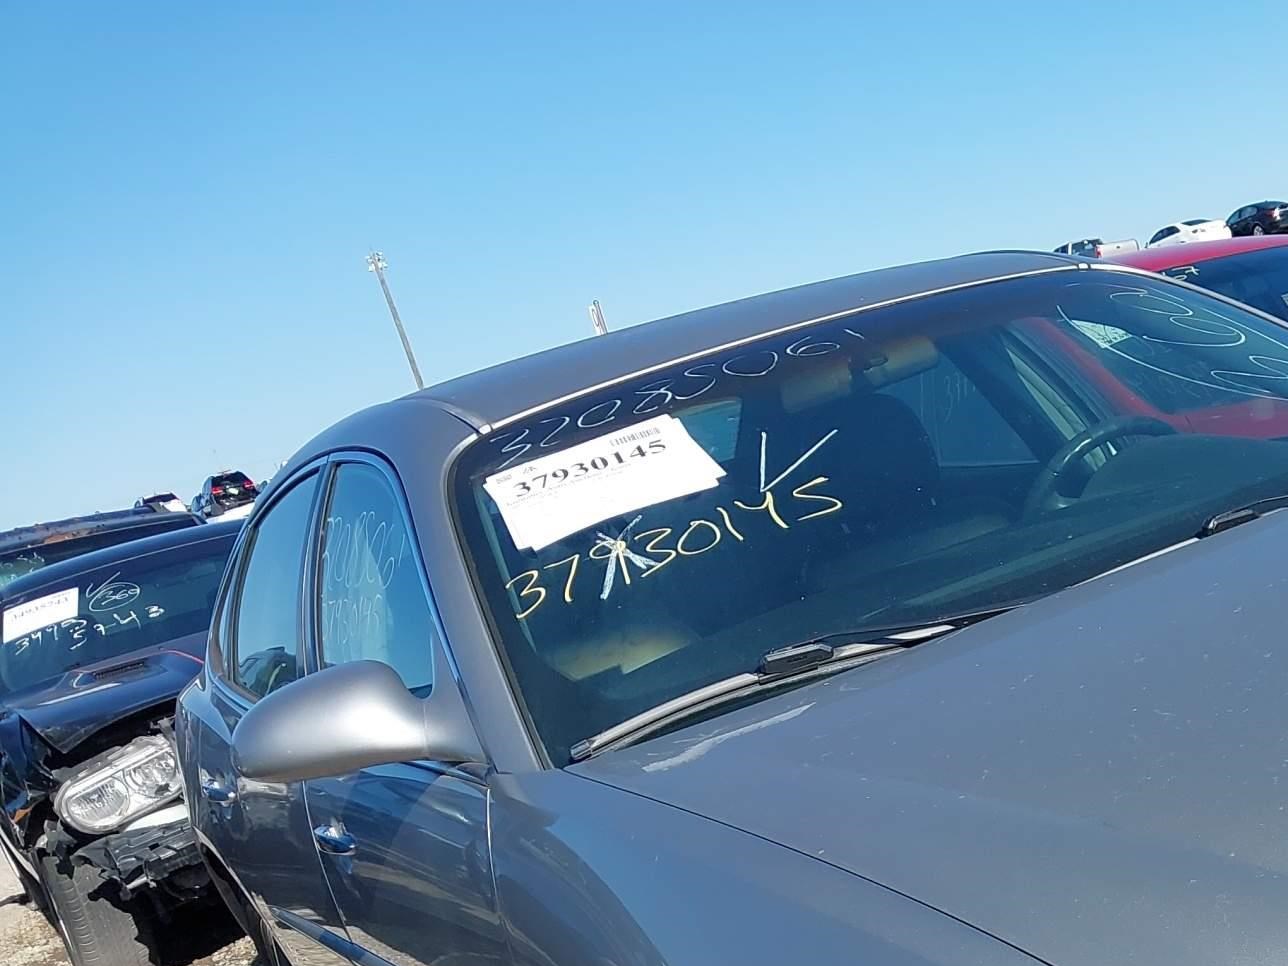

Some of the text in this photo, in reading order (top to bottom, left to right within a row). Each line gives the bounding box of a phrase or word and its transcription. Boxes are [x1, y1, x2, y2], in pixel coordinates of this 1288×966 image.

[488, 328, 866, 470] 32085061
[513, 438, 667, 498] 37930145
[505, 476, 843, 620] 37930145
